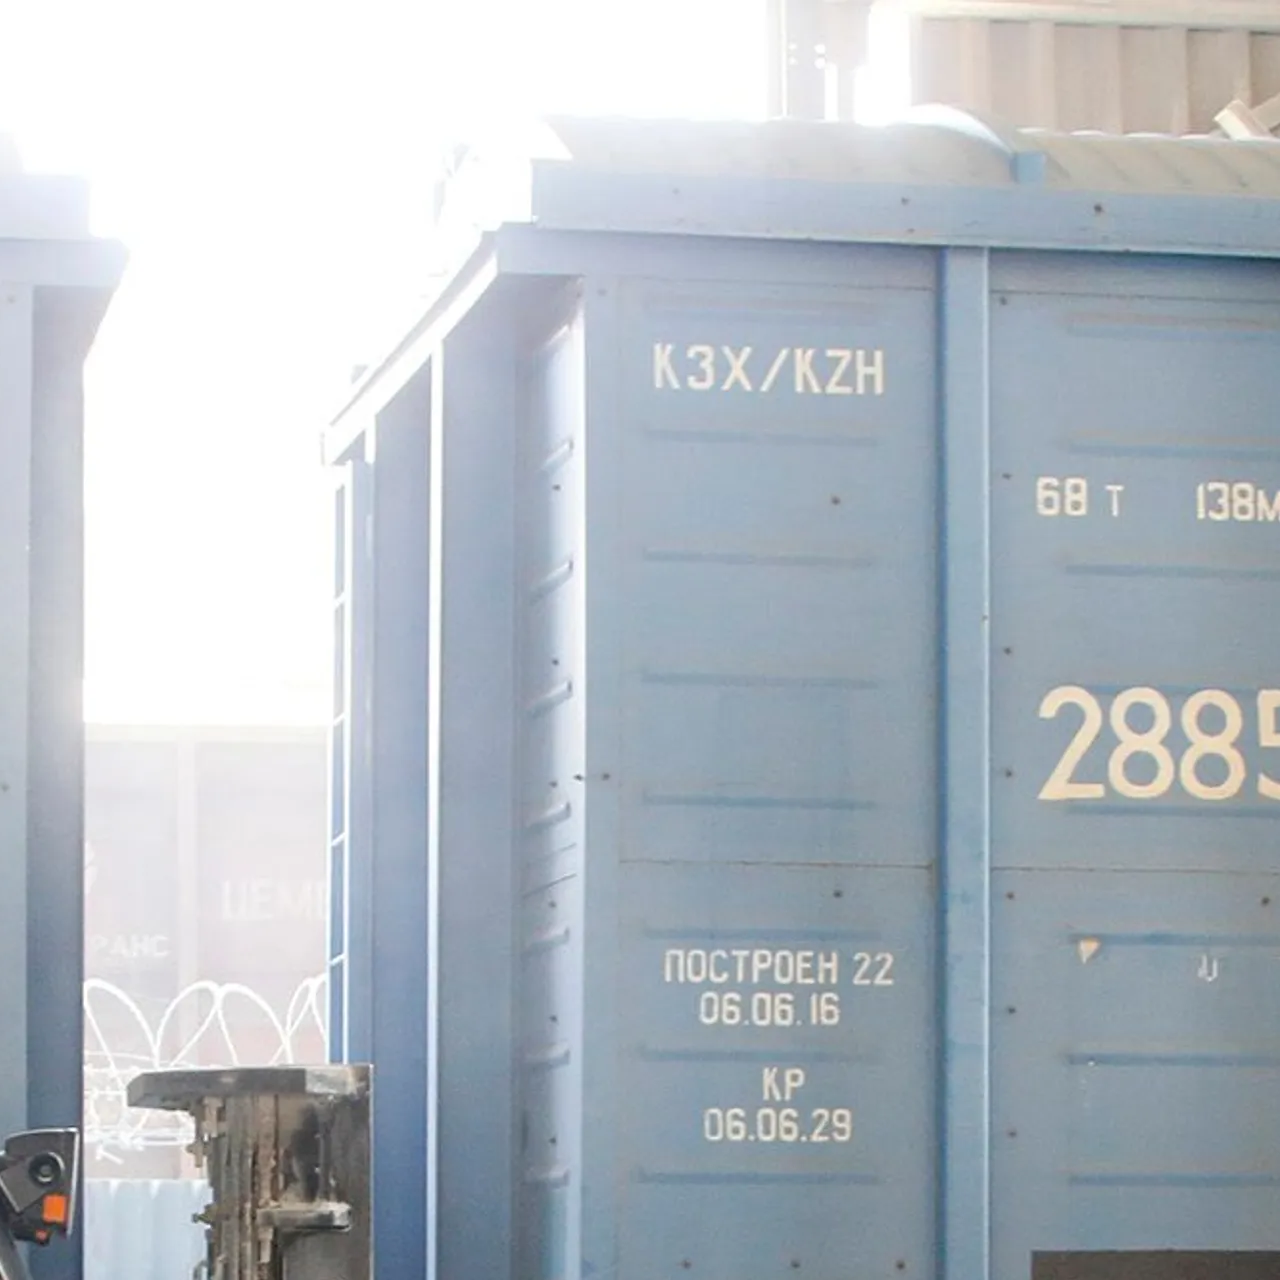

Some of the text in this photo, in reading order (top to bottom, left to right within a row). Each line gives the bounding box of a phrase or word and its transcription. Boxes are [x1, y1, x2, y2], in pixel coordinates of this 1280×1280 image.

[1036, 477, 1087, 516] 68
[665, 950, 894, 986] ПОСТРОЕН 22
[699, 992, 840, 1026] 06.06.16
[762, 1067, 805, 1100] КР
[704, 1109, 852, 1142] 06.06.29
